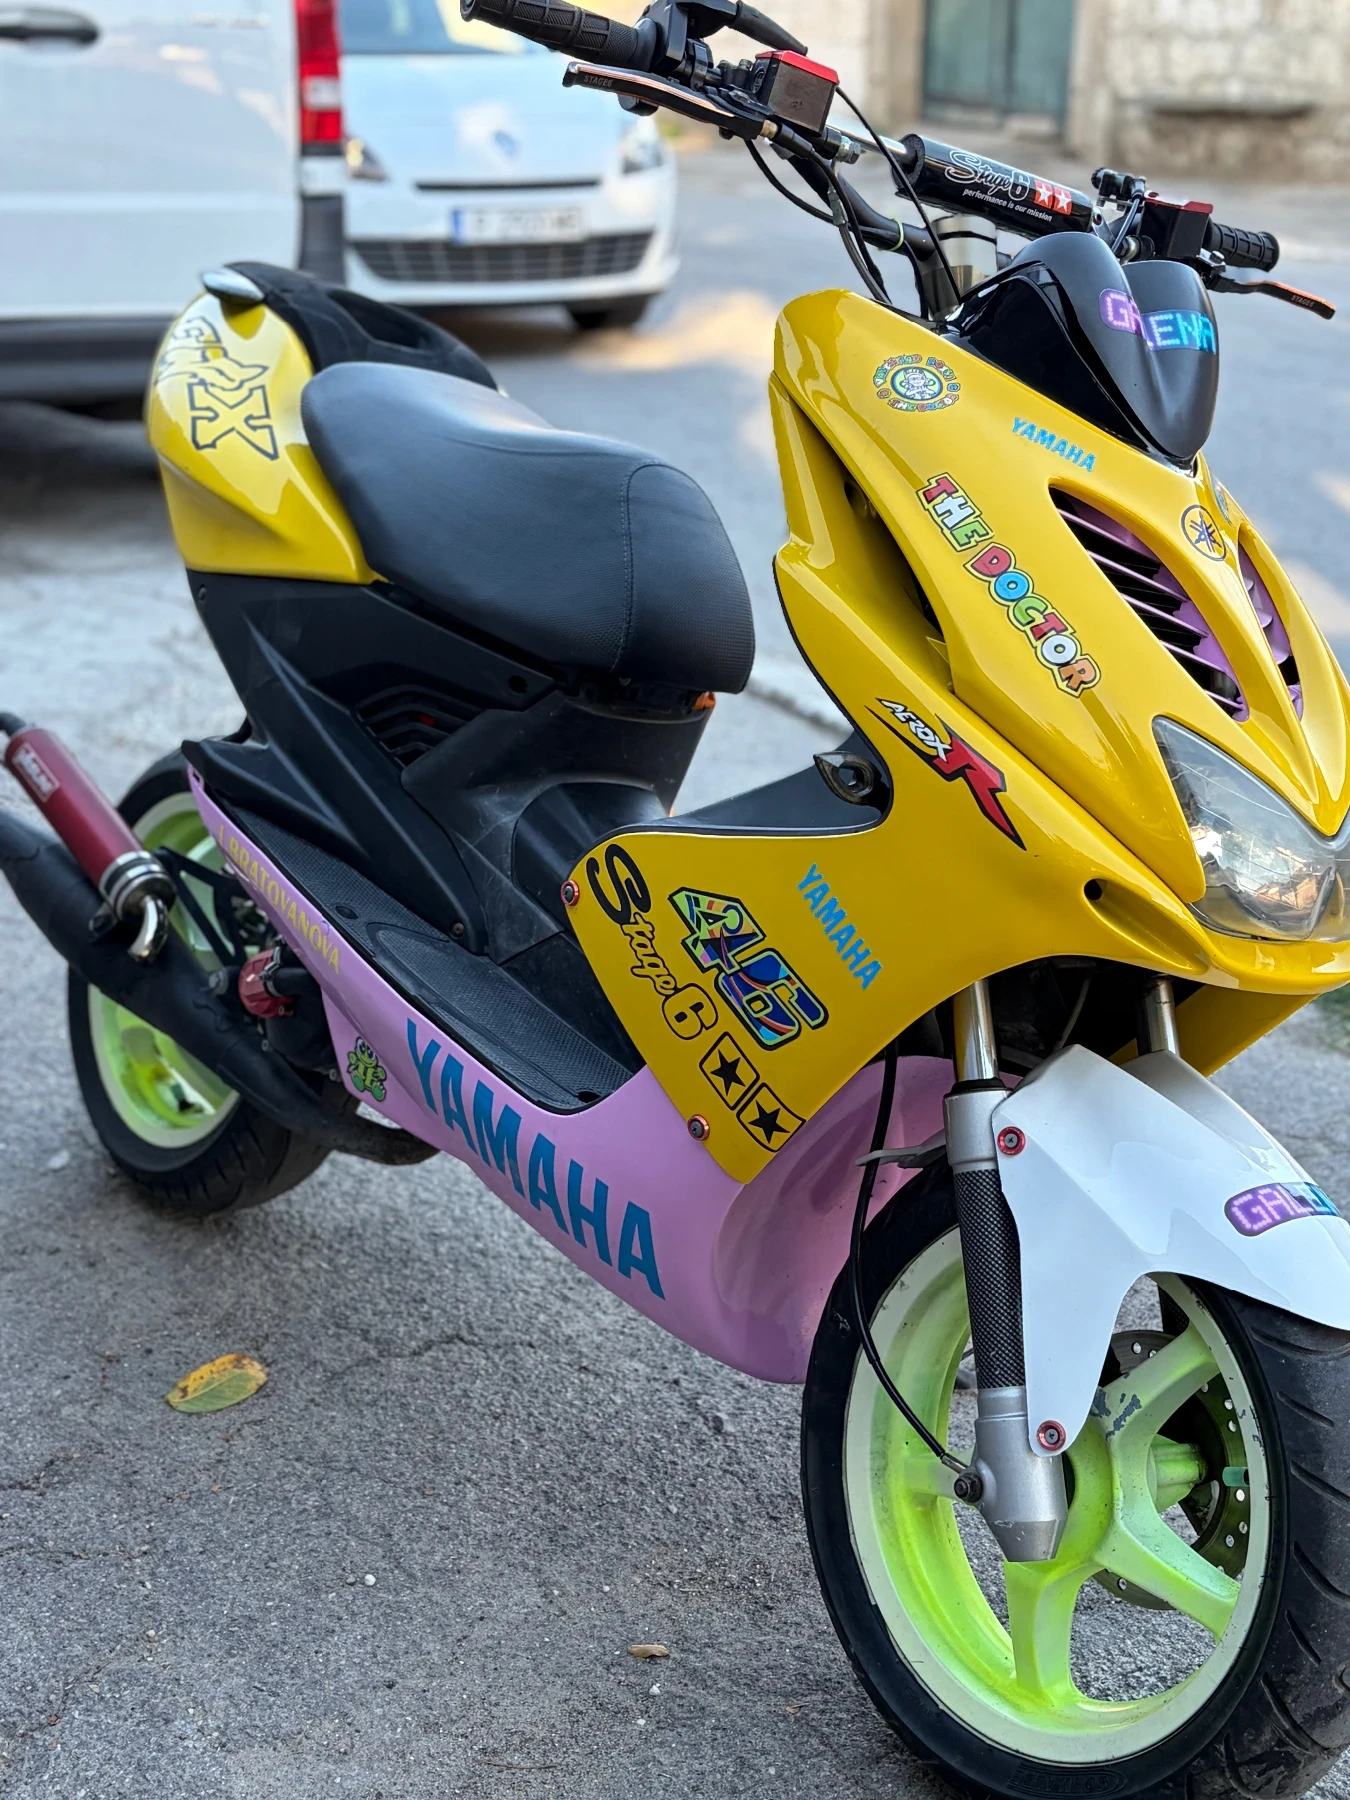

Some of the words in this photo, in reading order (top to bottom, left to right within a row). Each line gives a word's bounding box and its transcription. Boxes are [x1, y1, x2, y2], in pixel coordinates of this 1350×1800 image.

[583, 75, 613, 87] STAGE6
[962, 188, 1007, 207] performance
[1007, 200, 1014, 209] is
[1014, 204, 1026, 213] our
[1026, 208, 1053, 222] mission
[1011, 416, 1097, 473] YAMAHA
[916, 472, 994, 552] THE
[963, 542, 1102, 697] DOCTOR
[667, 886, 830, 1052] 46
[797, 862, 883, 990] YAMAHA
[407, 1017, 666, 1301] YAMAHA
